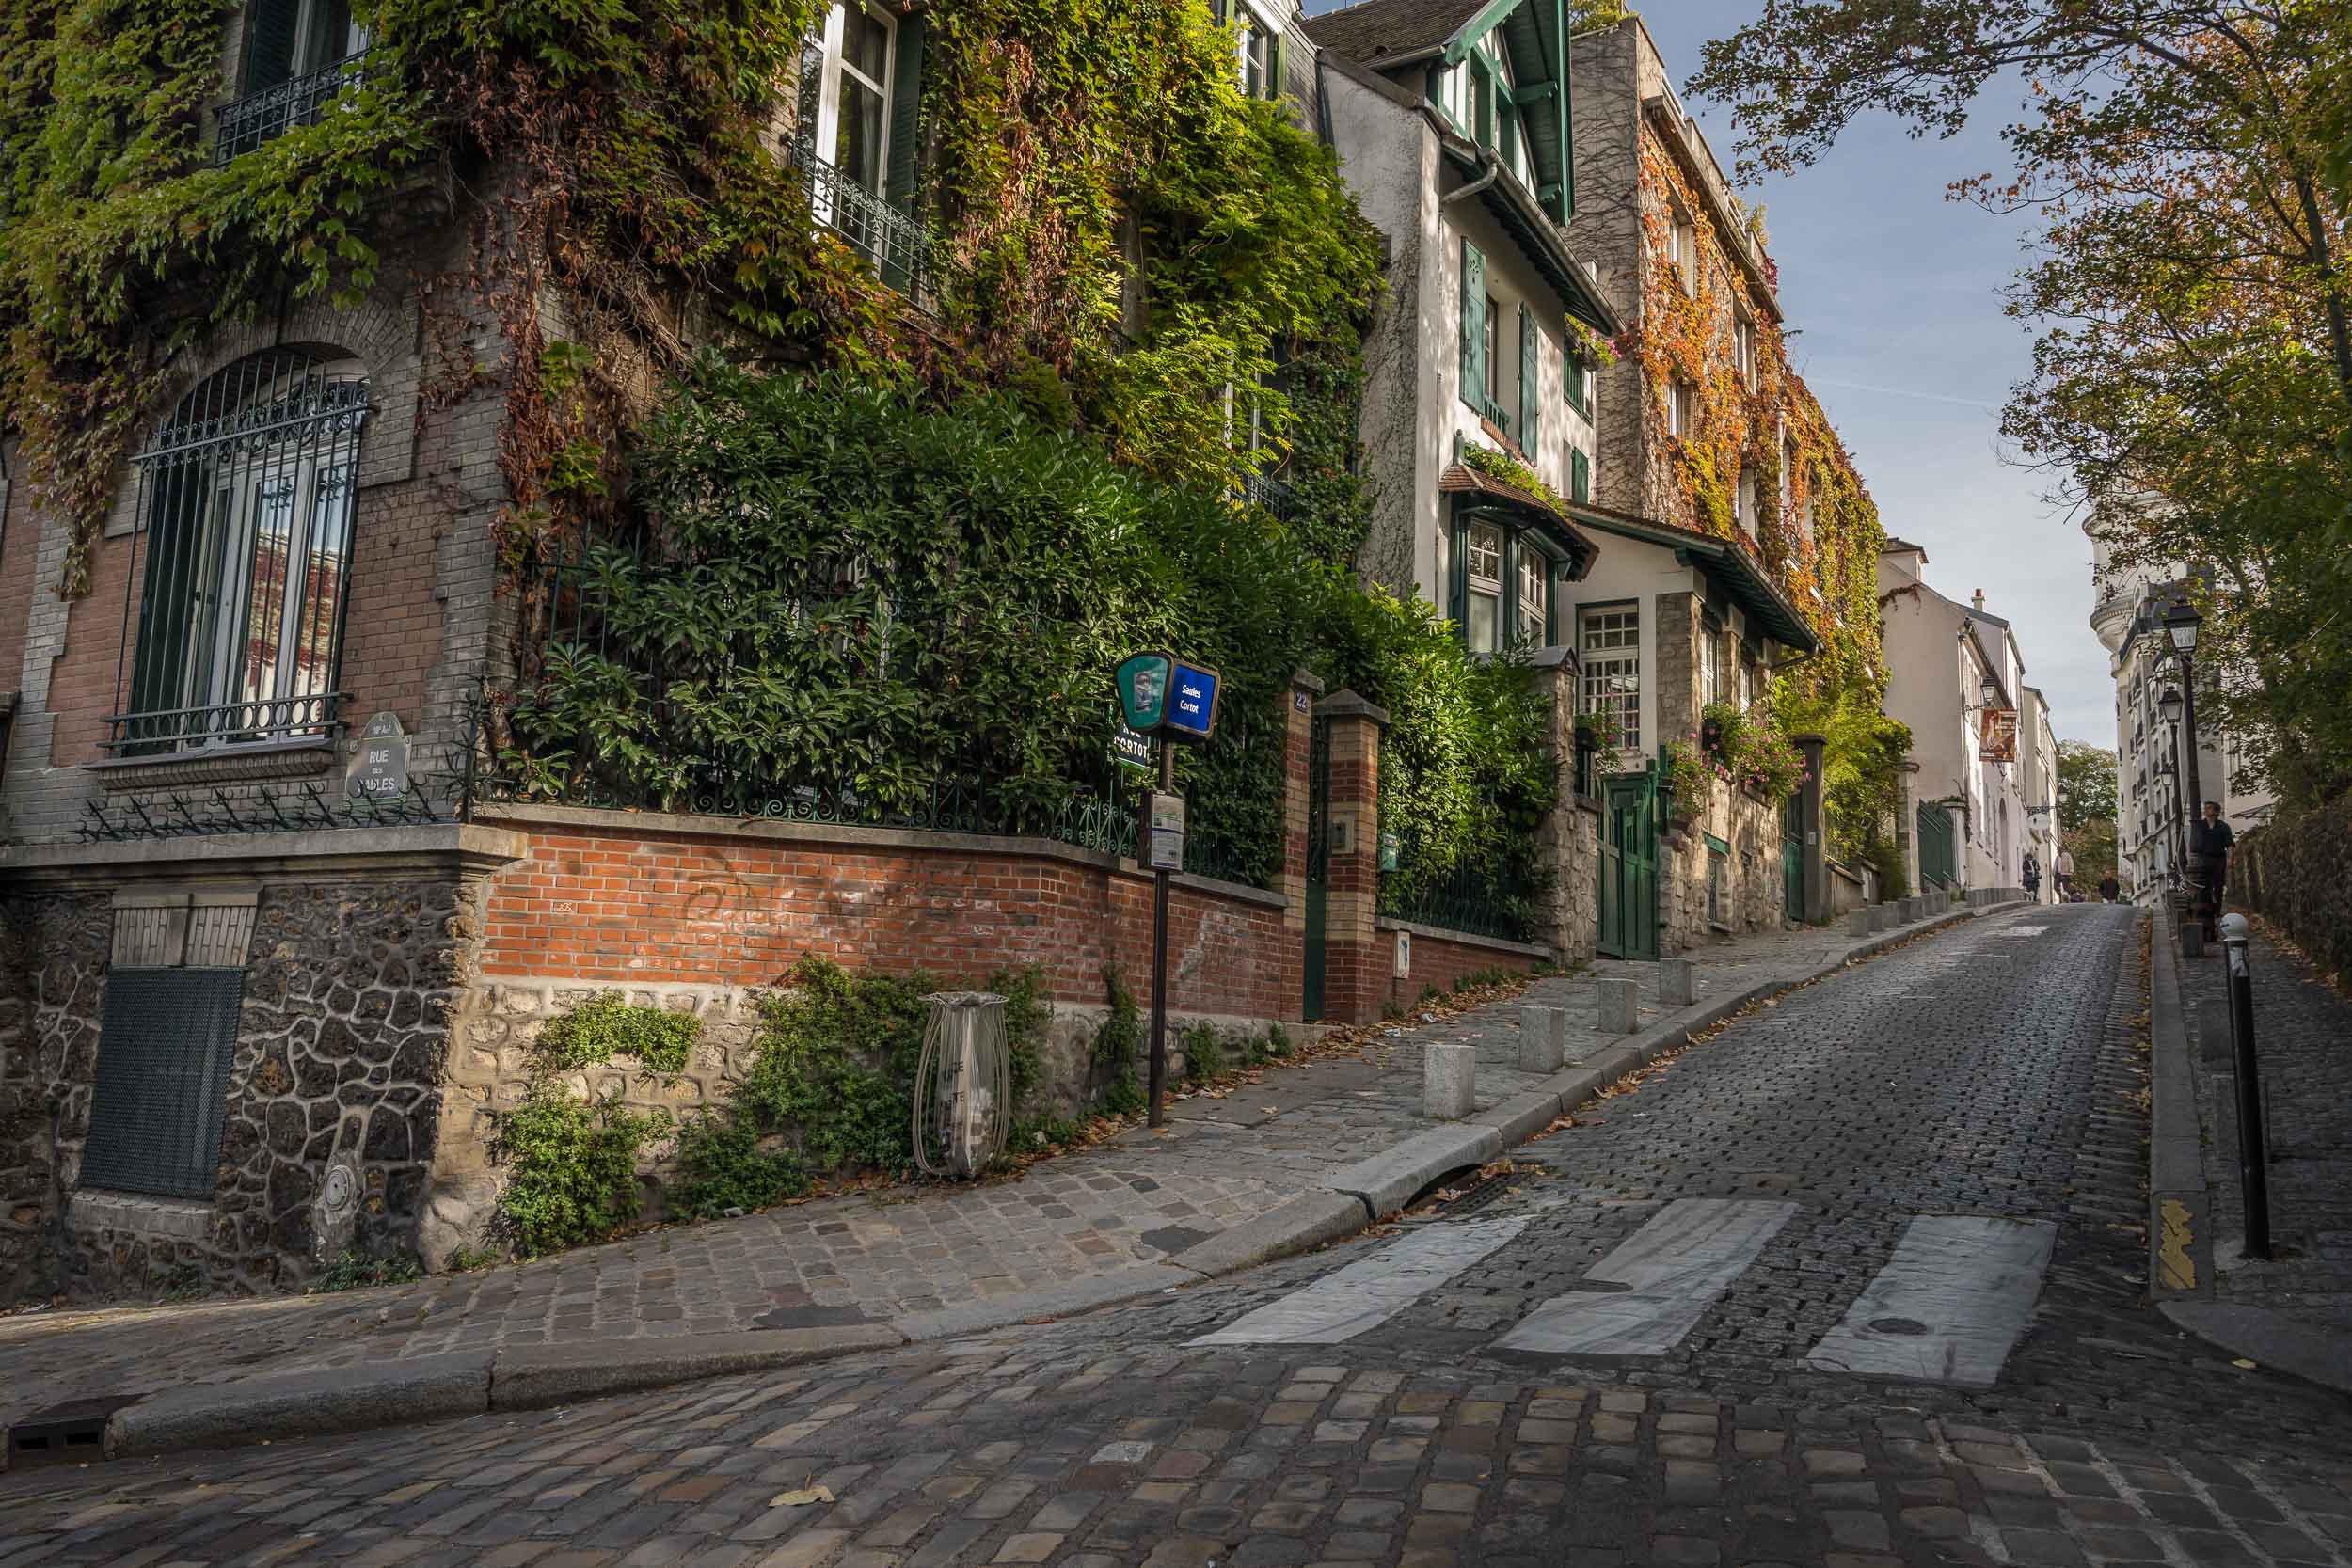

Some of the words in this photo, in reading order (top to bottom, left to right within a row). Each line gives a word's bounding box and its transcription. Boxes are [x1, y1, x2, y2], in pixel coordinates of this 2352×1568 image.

[1182, 684, 1201, 699] Saules
[1179, 699, 1200, 714] Cortot
[370, 750, 389, 763] RUE
[359, 777, 395, 792] AULES
